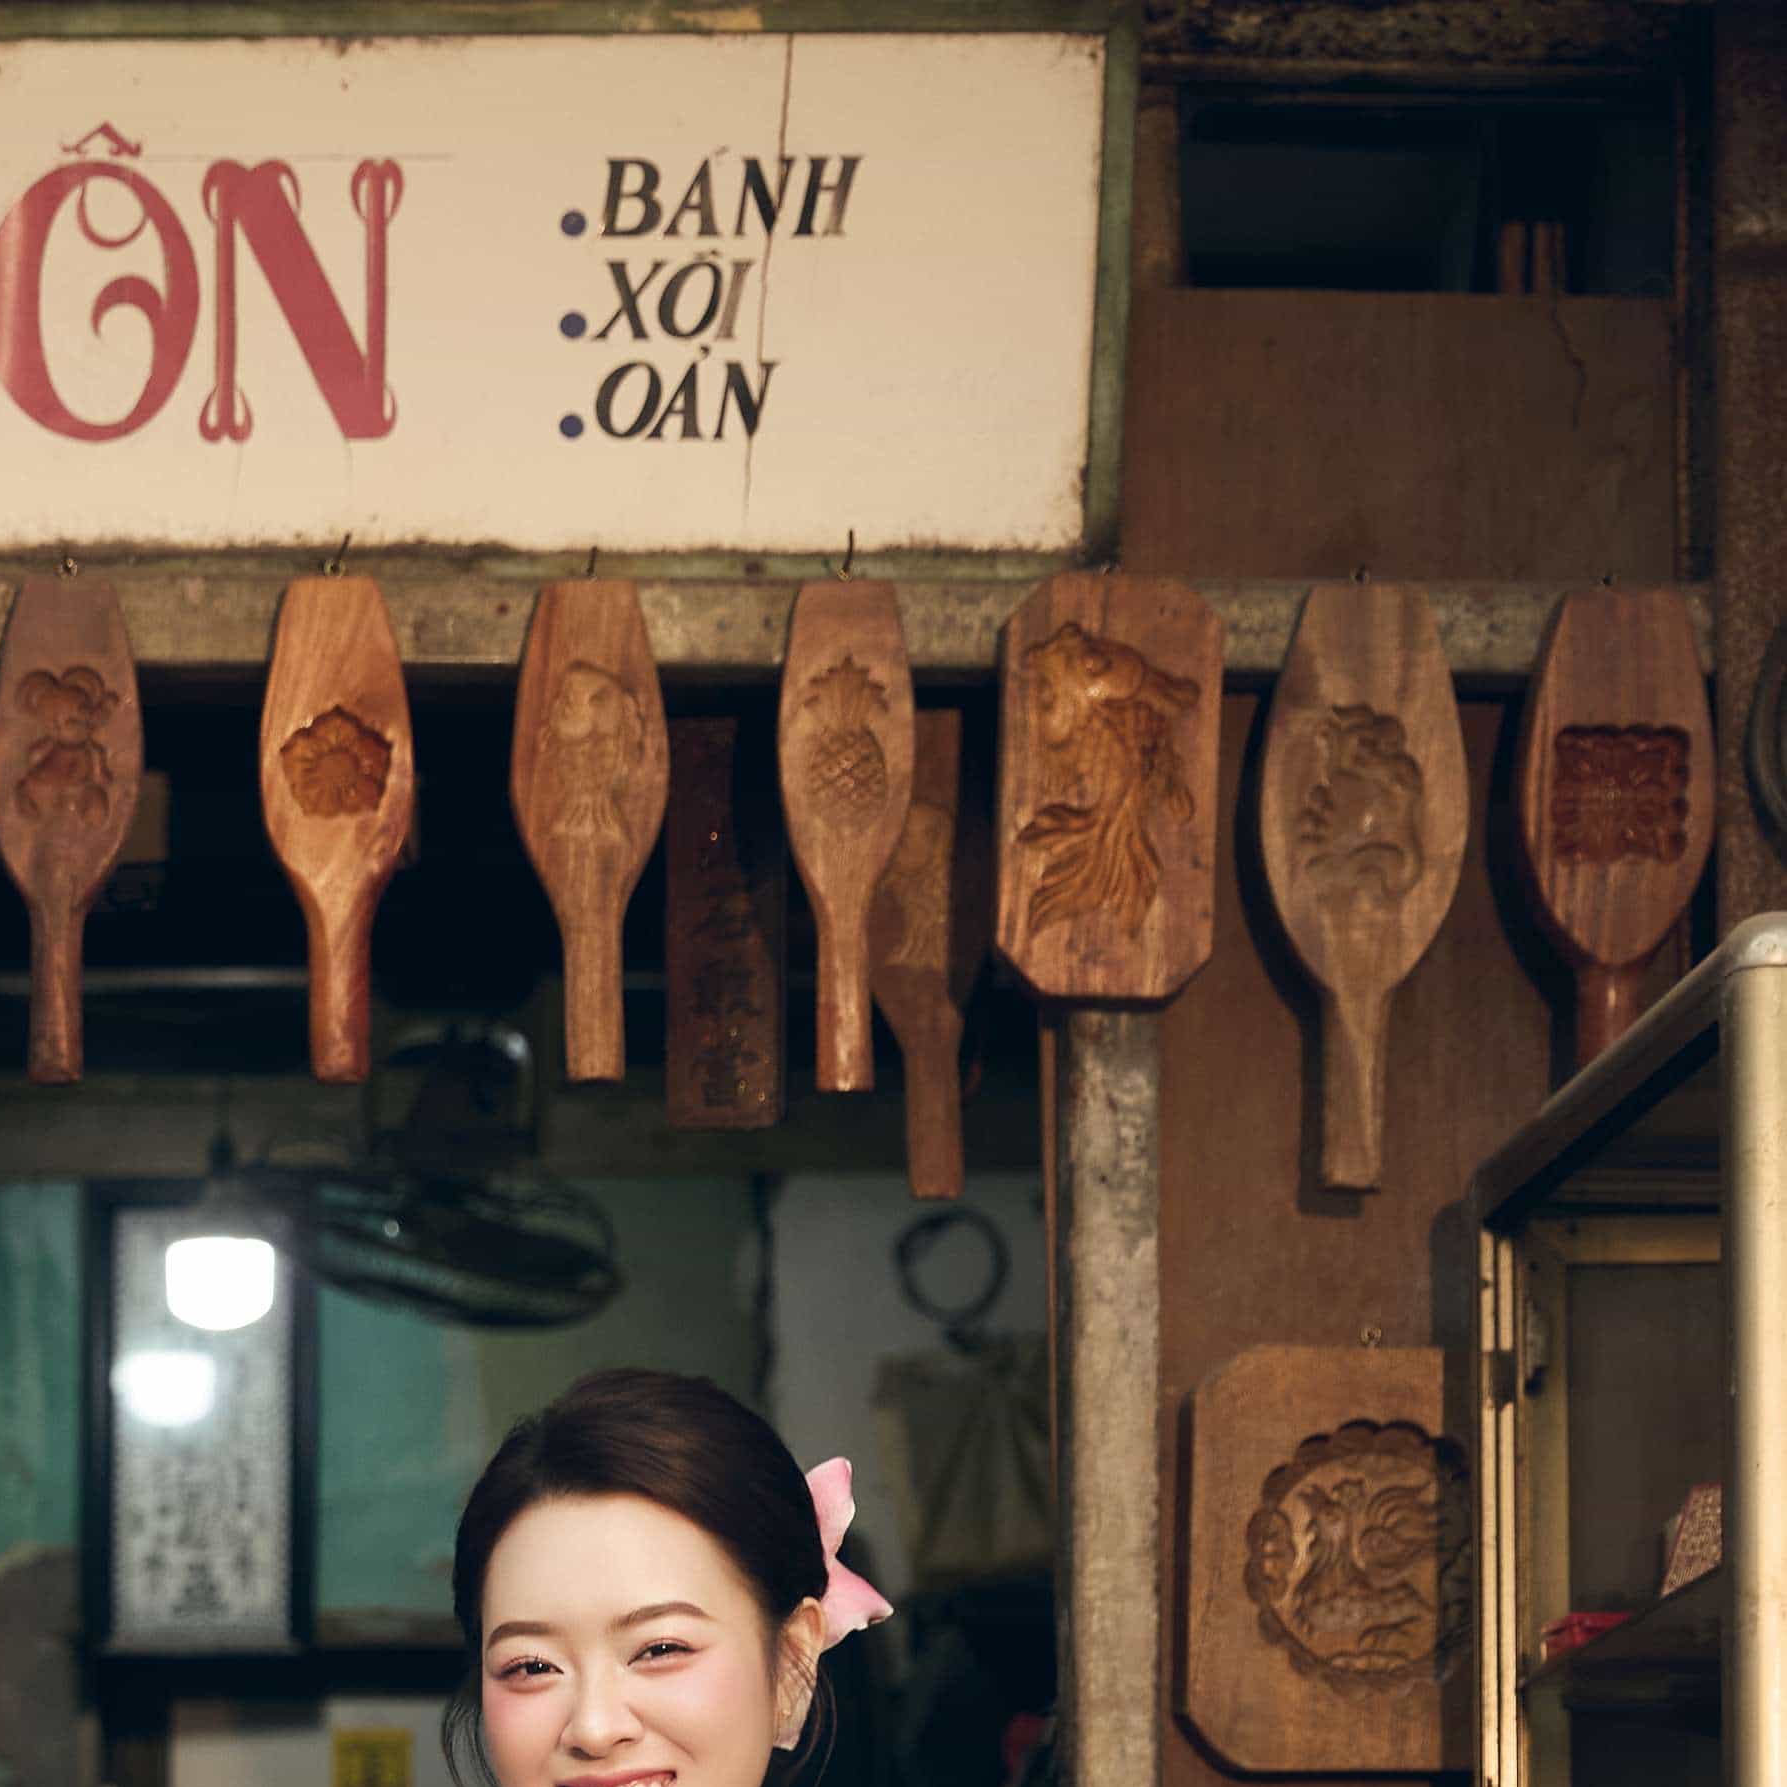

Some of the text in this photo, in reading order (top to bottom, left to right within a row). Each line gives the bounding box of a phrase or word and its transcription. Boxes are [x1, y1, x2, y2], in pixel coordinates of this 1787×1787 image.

[600, 146, 863, 238] BÁNH
[592, 249, 754, 341] XÔI
[595, 346, 780, 440] OẢN
